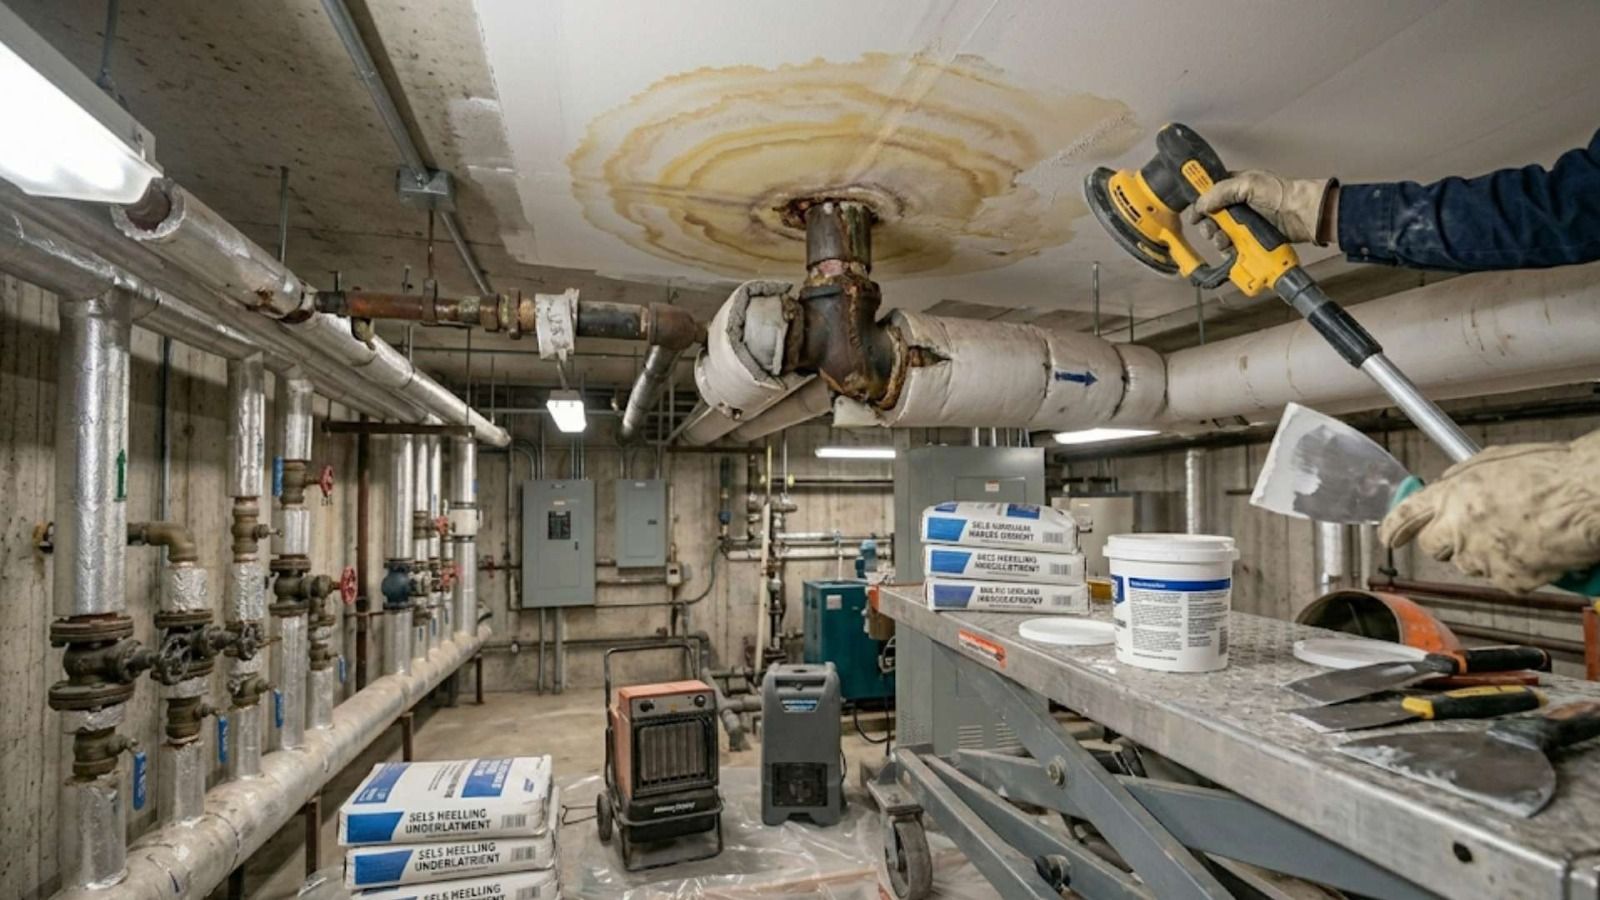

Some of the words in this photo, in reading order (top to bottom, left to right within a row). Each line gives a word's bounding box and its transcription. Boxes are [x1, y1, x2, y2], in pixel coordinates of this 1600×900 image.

[409, 811, 435, 823] SELS
[437, 808, 487, 820] HEELLING
[418, 847, 444, 860] SELS
[446, 842, 496, 856] HEELLING
